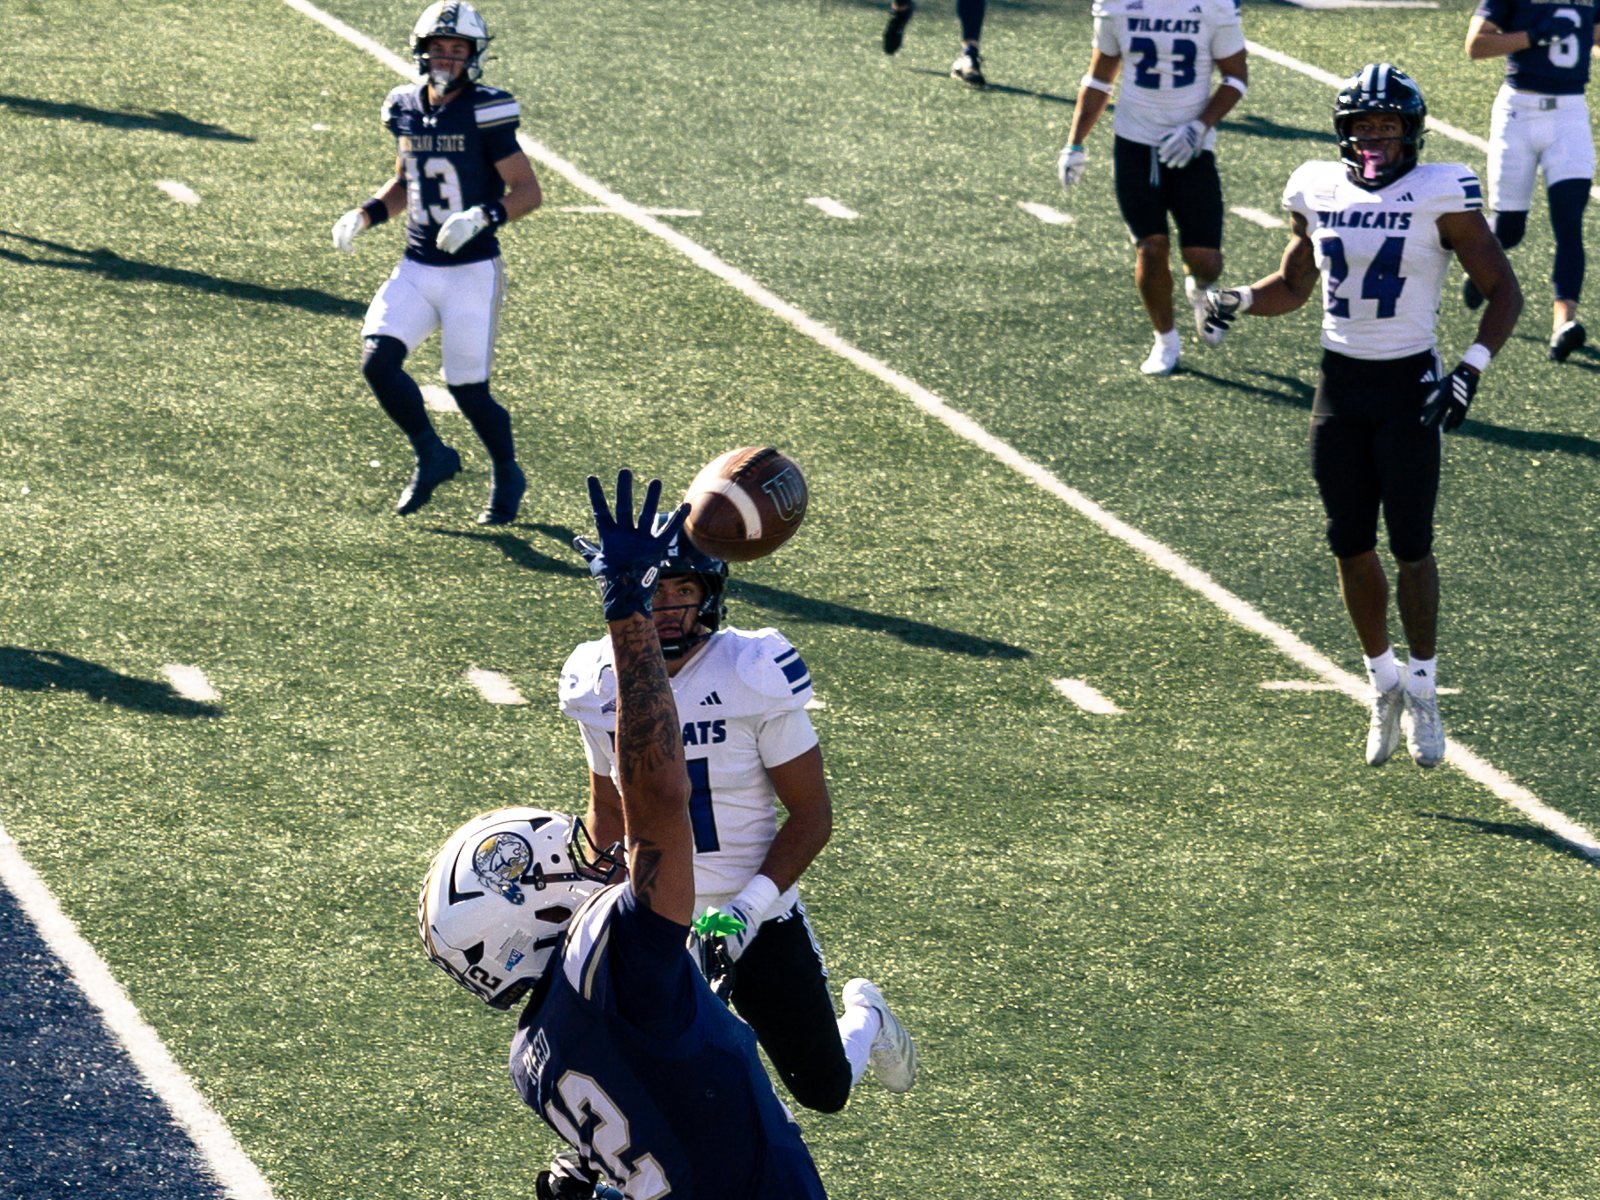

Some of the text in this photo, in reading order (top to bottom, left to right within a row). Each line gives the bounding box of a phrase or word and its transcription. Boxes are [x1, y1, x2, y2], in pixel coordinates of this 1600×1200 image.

[1127, 18, 1201, 34] WILDCATS
[1129, 37, 1198, 90] 23
[436, 134, 465, 152] STATE
[404, 157, 464, 225] 13
[1317, 210, 1412, 231] WILDCATS
[1319, 236, 1407, 319] 24
[522, 1027, 551, 1086] REED
